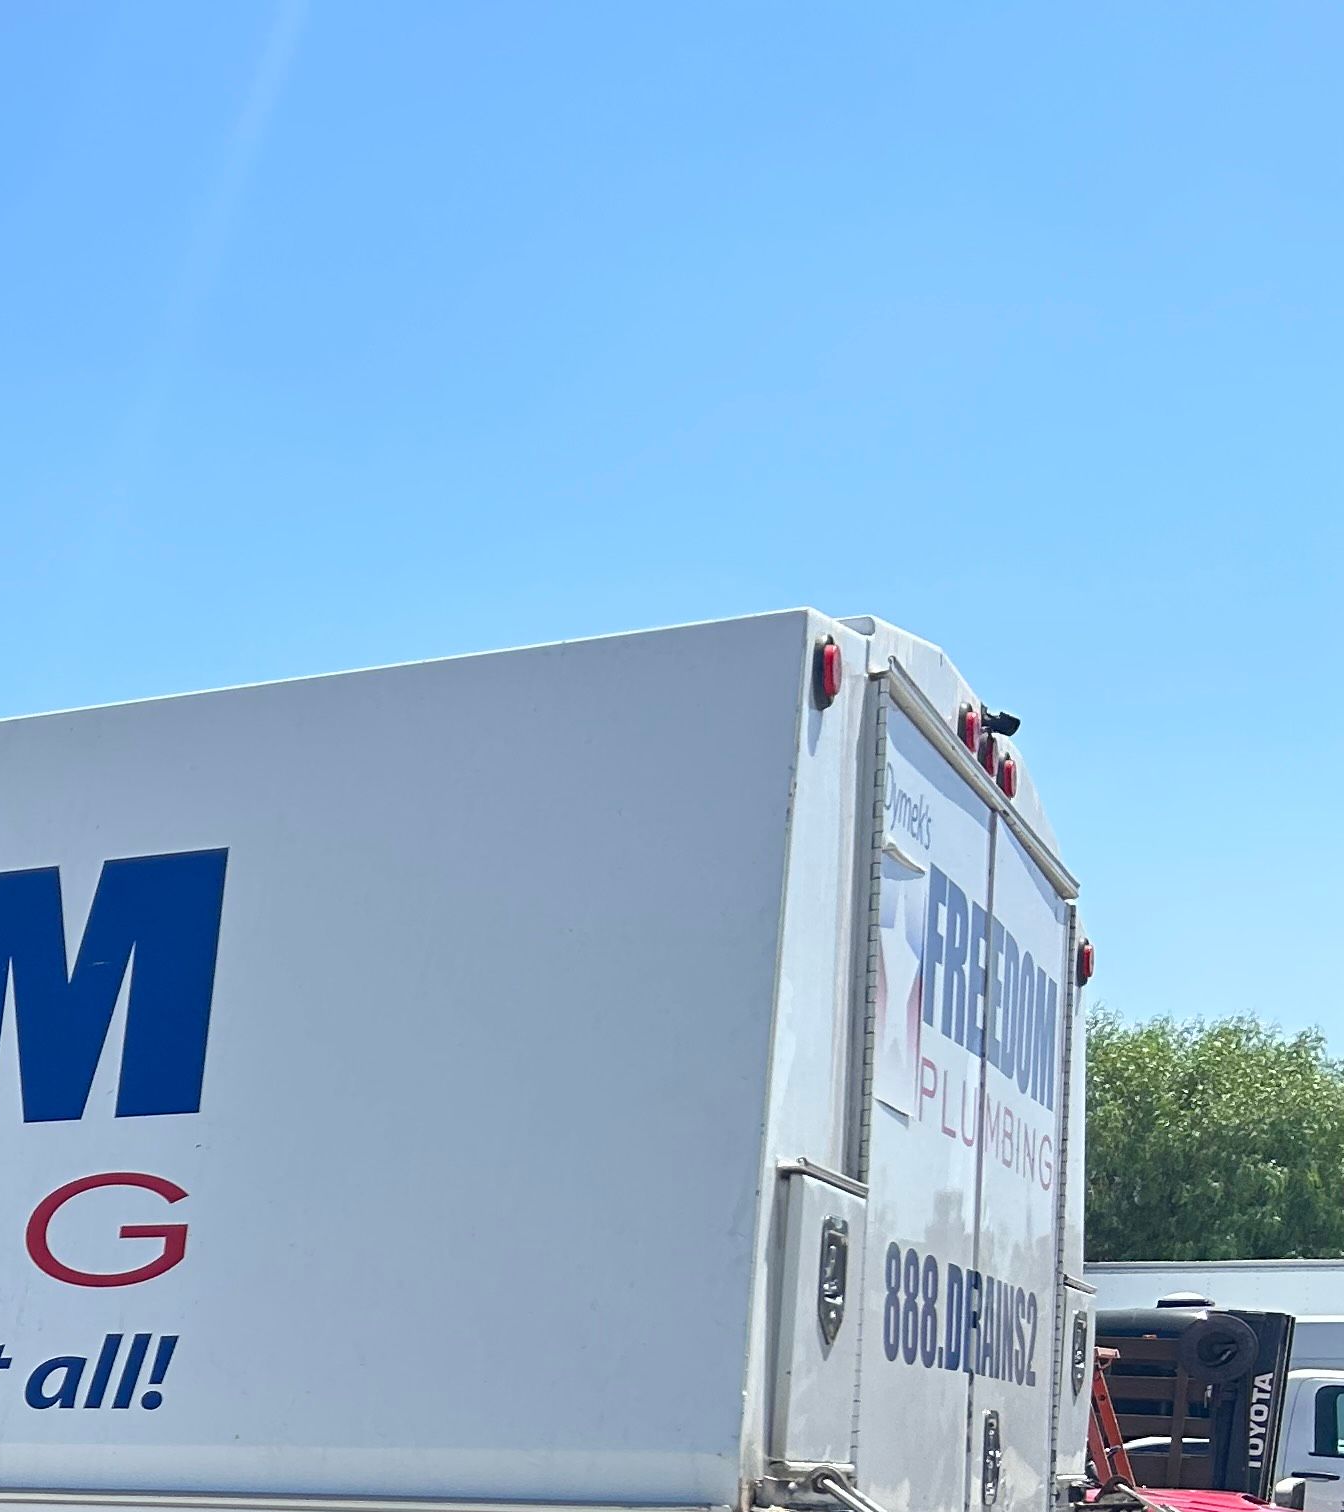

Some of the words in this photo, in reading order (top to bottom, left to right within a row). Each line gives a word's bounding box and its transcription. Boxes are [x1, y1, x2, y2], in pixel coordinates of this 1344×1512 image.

[923, 862, 1057, 1112] FREEDOM
[918, 1056, 1053, 1191] PLUMBING
[25, 1333, 179, 1410] all!
[883, 1241, 1037, 1387] 888.DRAINS2
